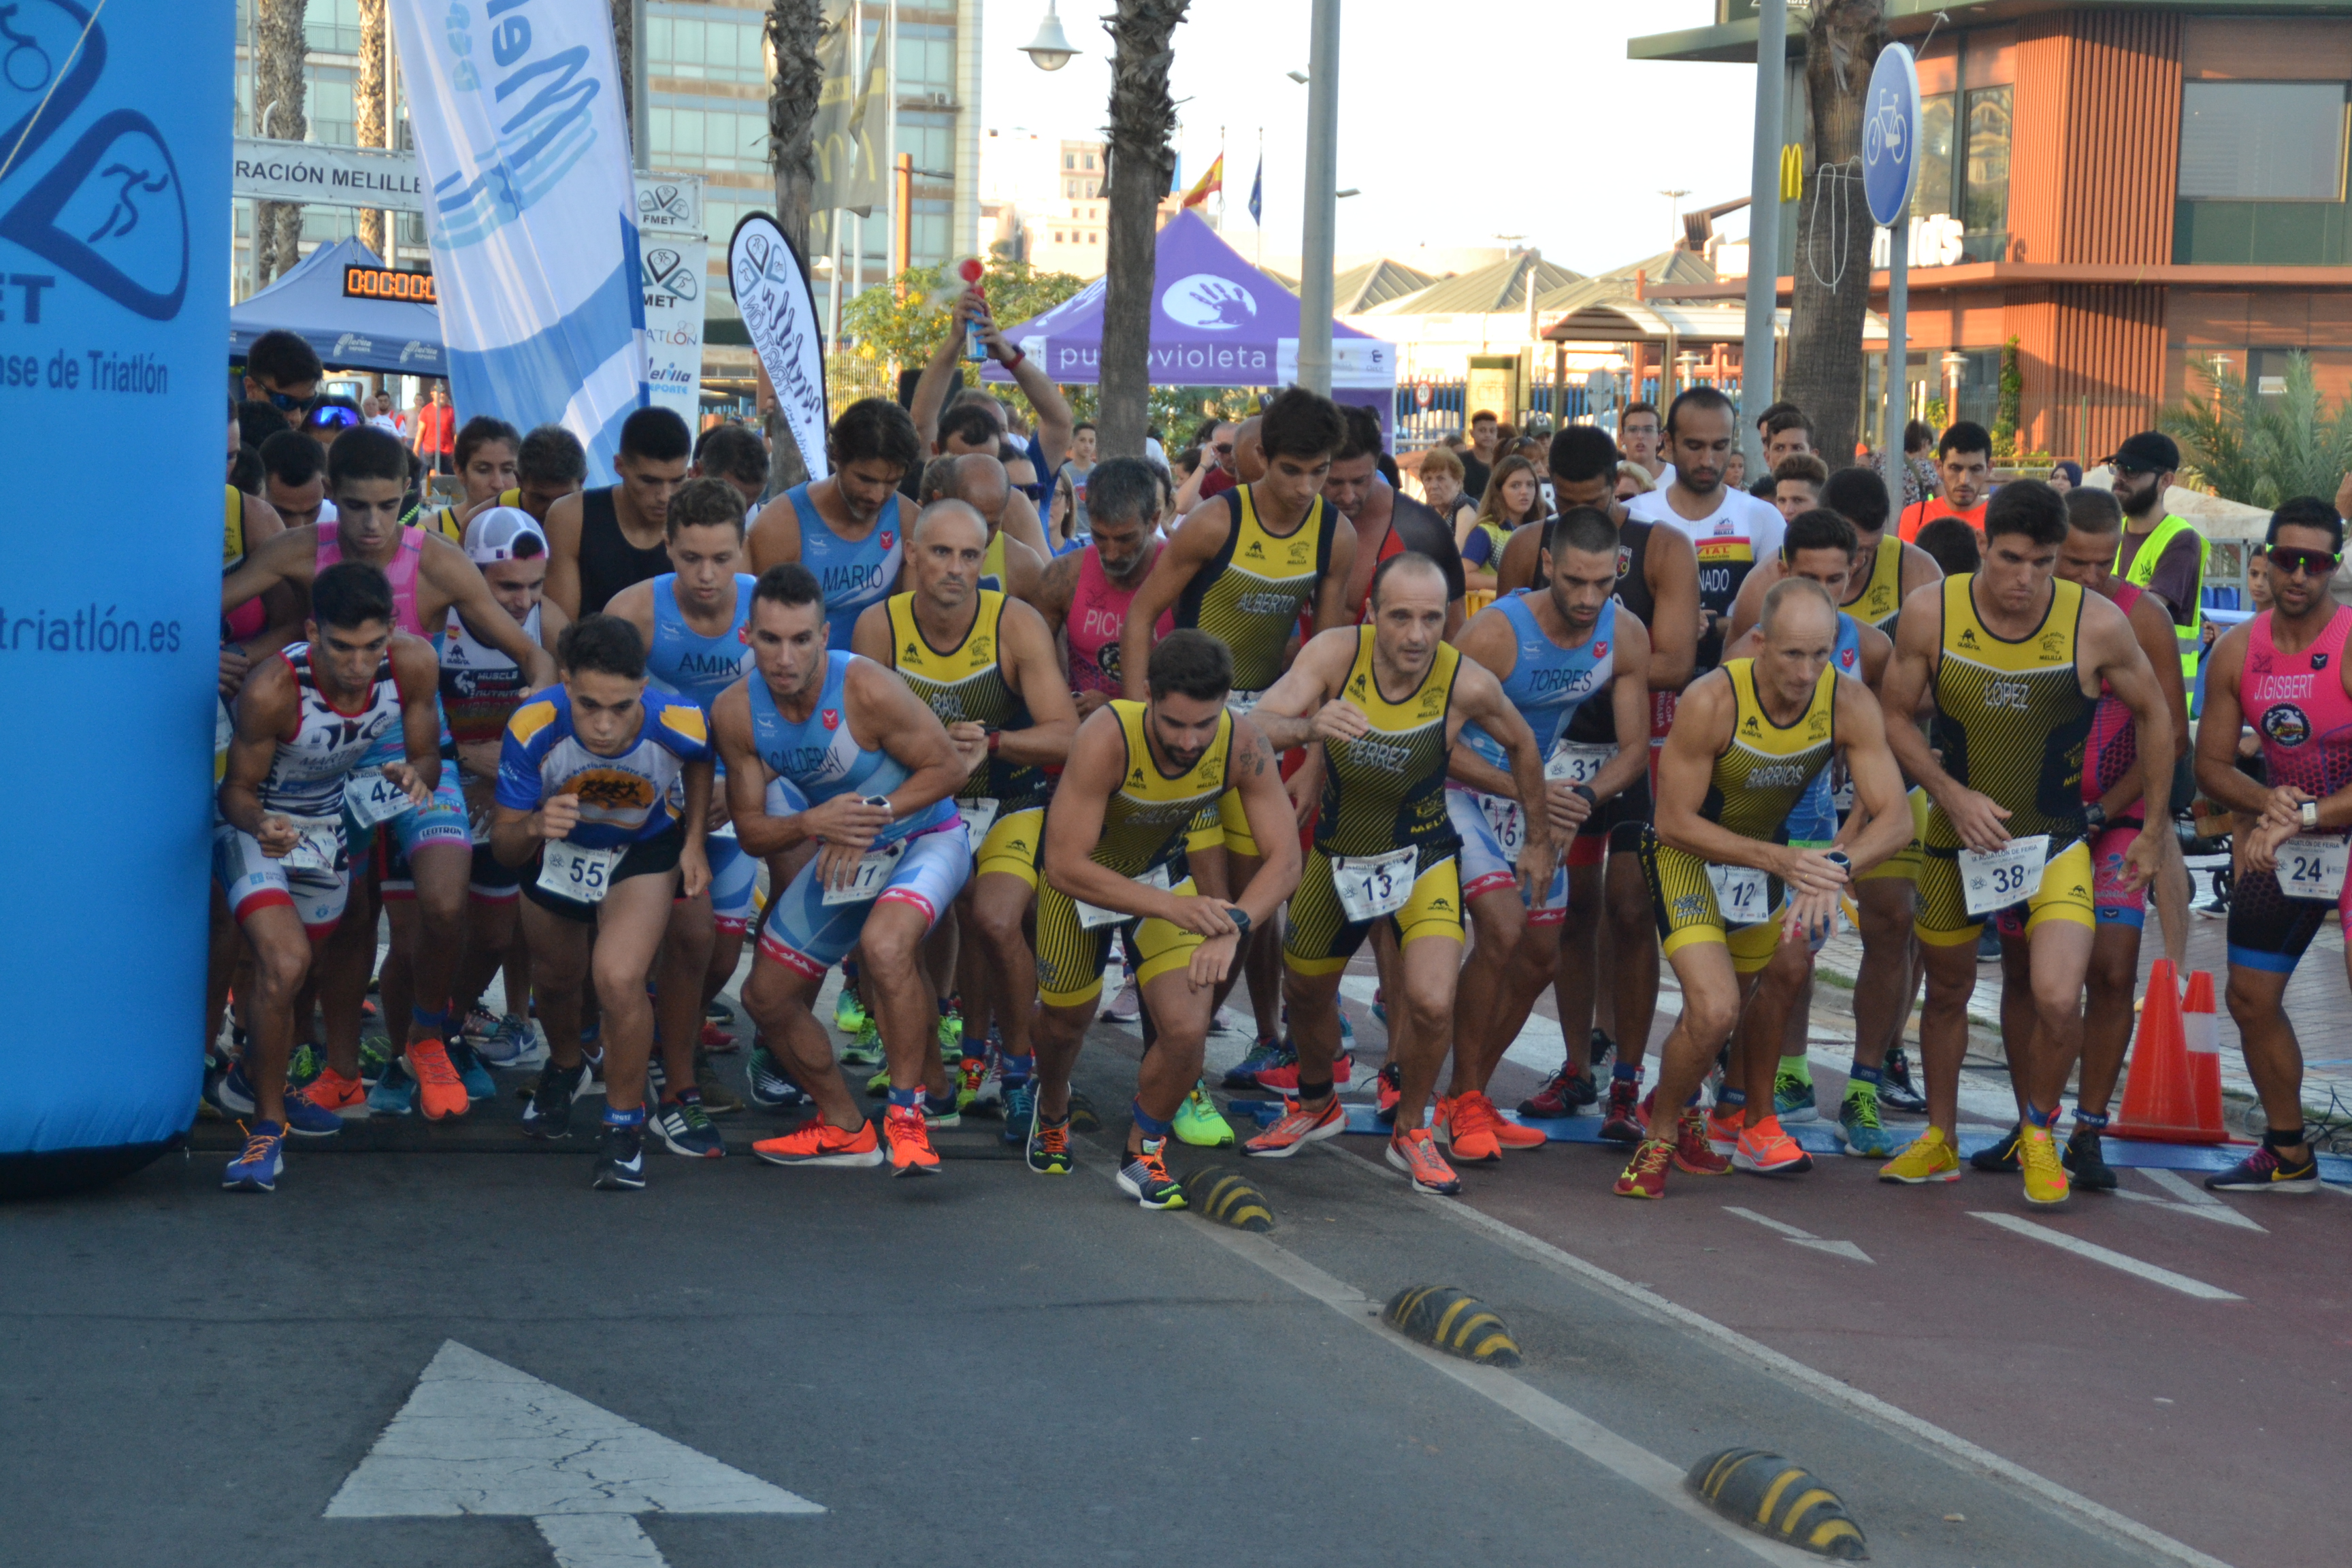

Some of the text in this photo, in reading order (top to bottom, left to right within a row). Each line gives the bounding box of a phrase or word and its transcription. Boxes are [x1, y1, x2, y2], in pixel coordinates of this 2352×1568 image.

[643, 214, 676, 225] FMET
[48, 349, 80, 389] de
[88, 350, 167, 394] Triatlón
[1419, 387, 1428, 398] 20
[822, 564, 883, 591] MARIO
[1236, 592, 1295, 613] ALBERTO
[478, 670, 519, 680] MUSCLE
[678, 653, 741, 675] AMIN
[1529, 669, 1592, 692] TORRES
[1985, 676, 2028, 708] LÓPEZ
[2254, 674, 2316, 700] J.GISBERT
[932, 687, 966, 717] RAÚL
[771, 746, 846, 774] CALDERAY
[1571, 760, 1601, 782] 31
[1745, 765, 1804, 787] BARRIOS
[371, 780, 403, 803] 42
[2021, 845, 2038, 853] FERIA
[570, 856, 605, 887] 55
[851, 865, 877, 887] 11
[1992, 864, 2025, 894] 38
[2291, 856, 2323, 883] 24
[1362, 873, 1392, 902] 13
[1732, 881, 1757, 906] 12
